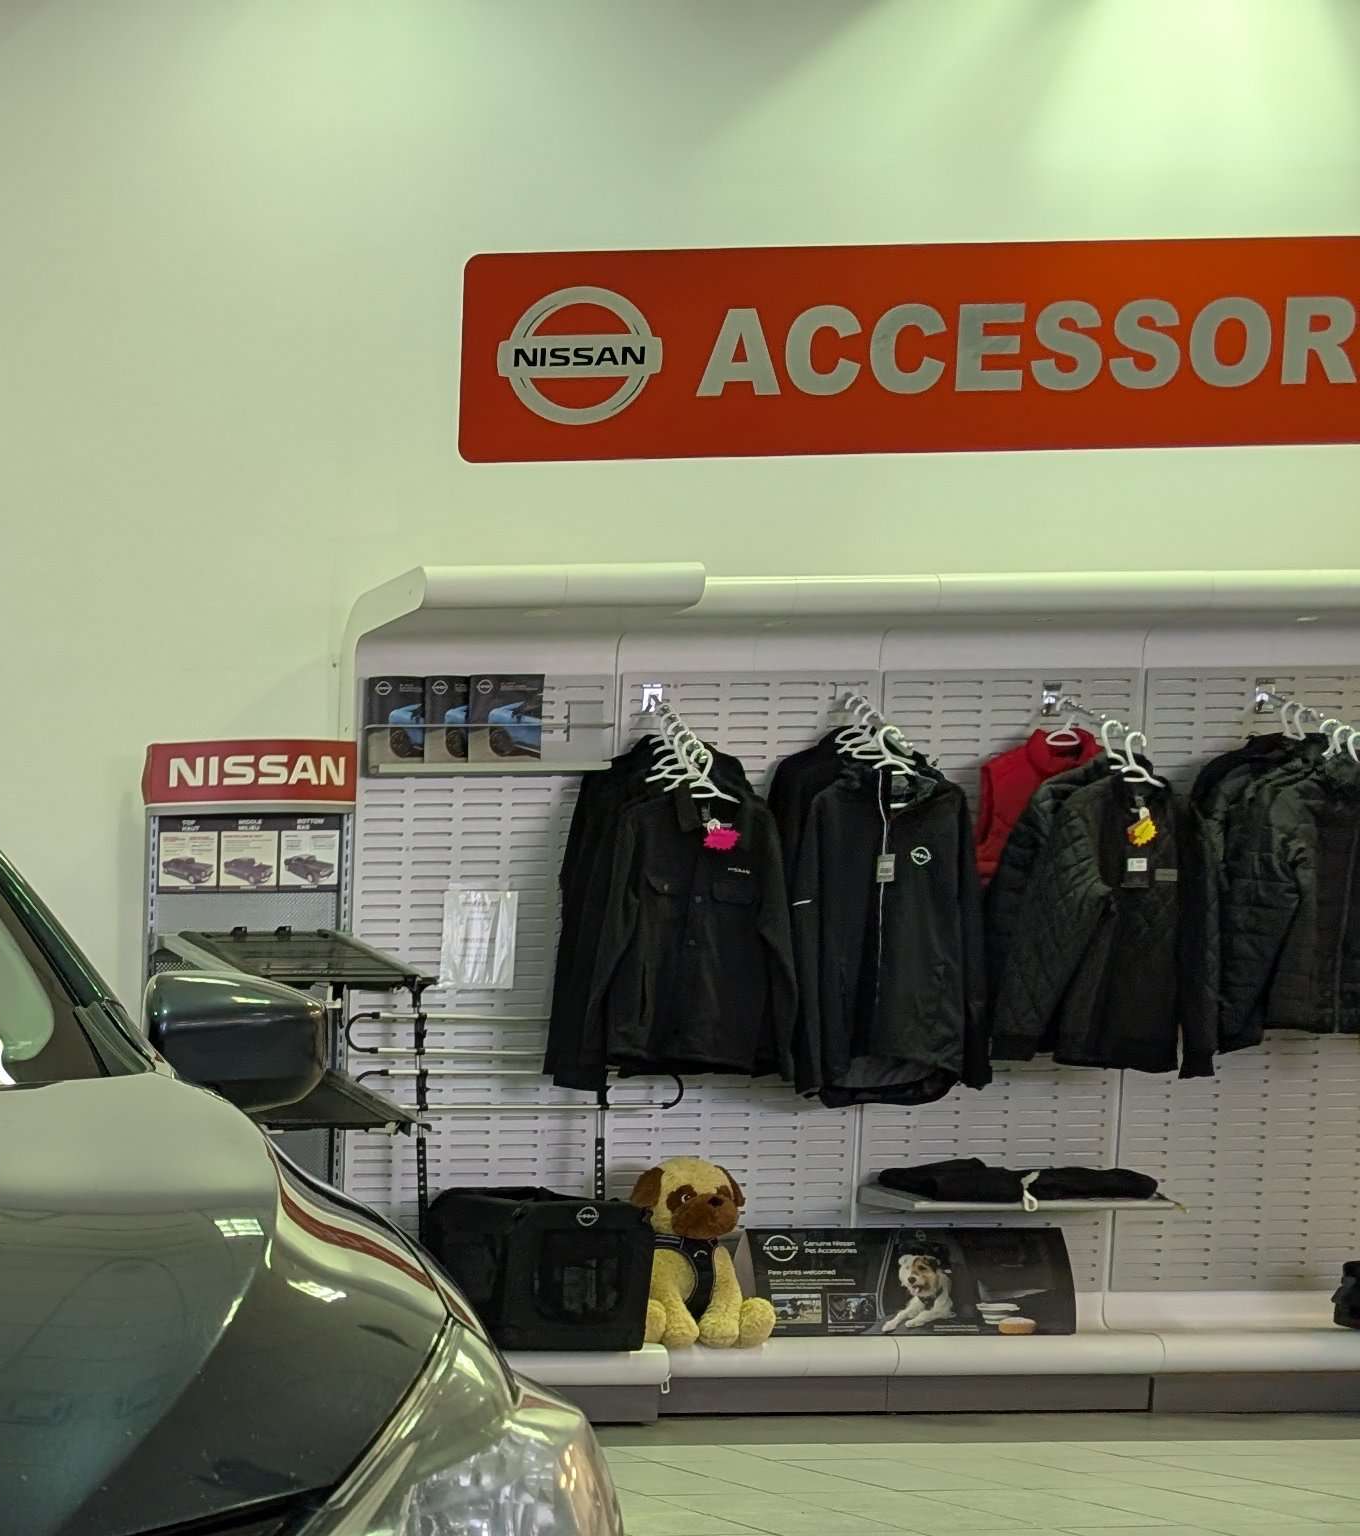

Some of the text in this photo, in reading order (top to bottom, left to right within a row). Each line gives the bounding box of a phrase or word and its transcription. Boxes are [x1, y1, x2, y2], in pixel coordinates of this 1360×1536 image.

[513, 345, 647, 369] NISSAN
[695, 296, 1358, 398] ACCESSOR
[167, 755, 347, 788] NISSAN
